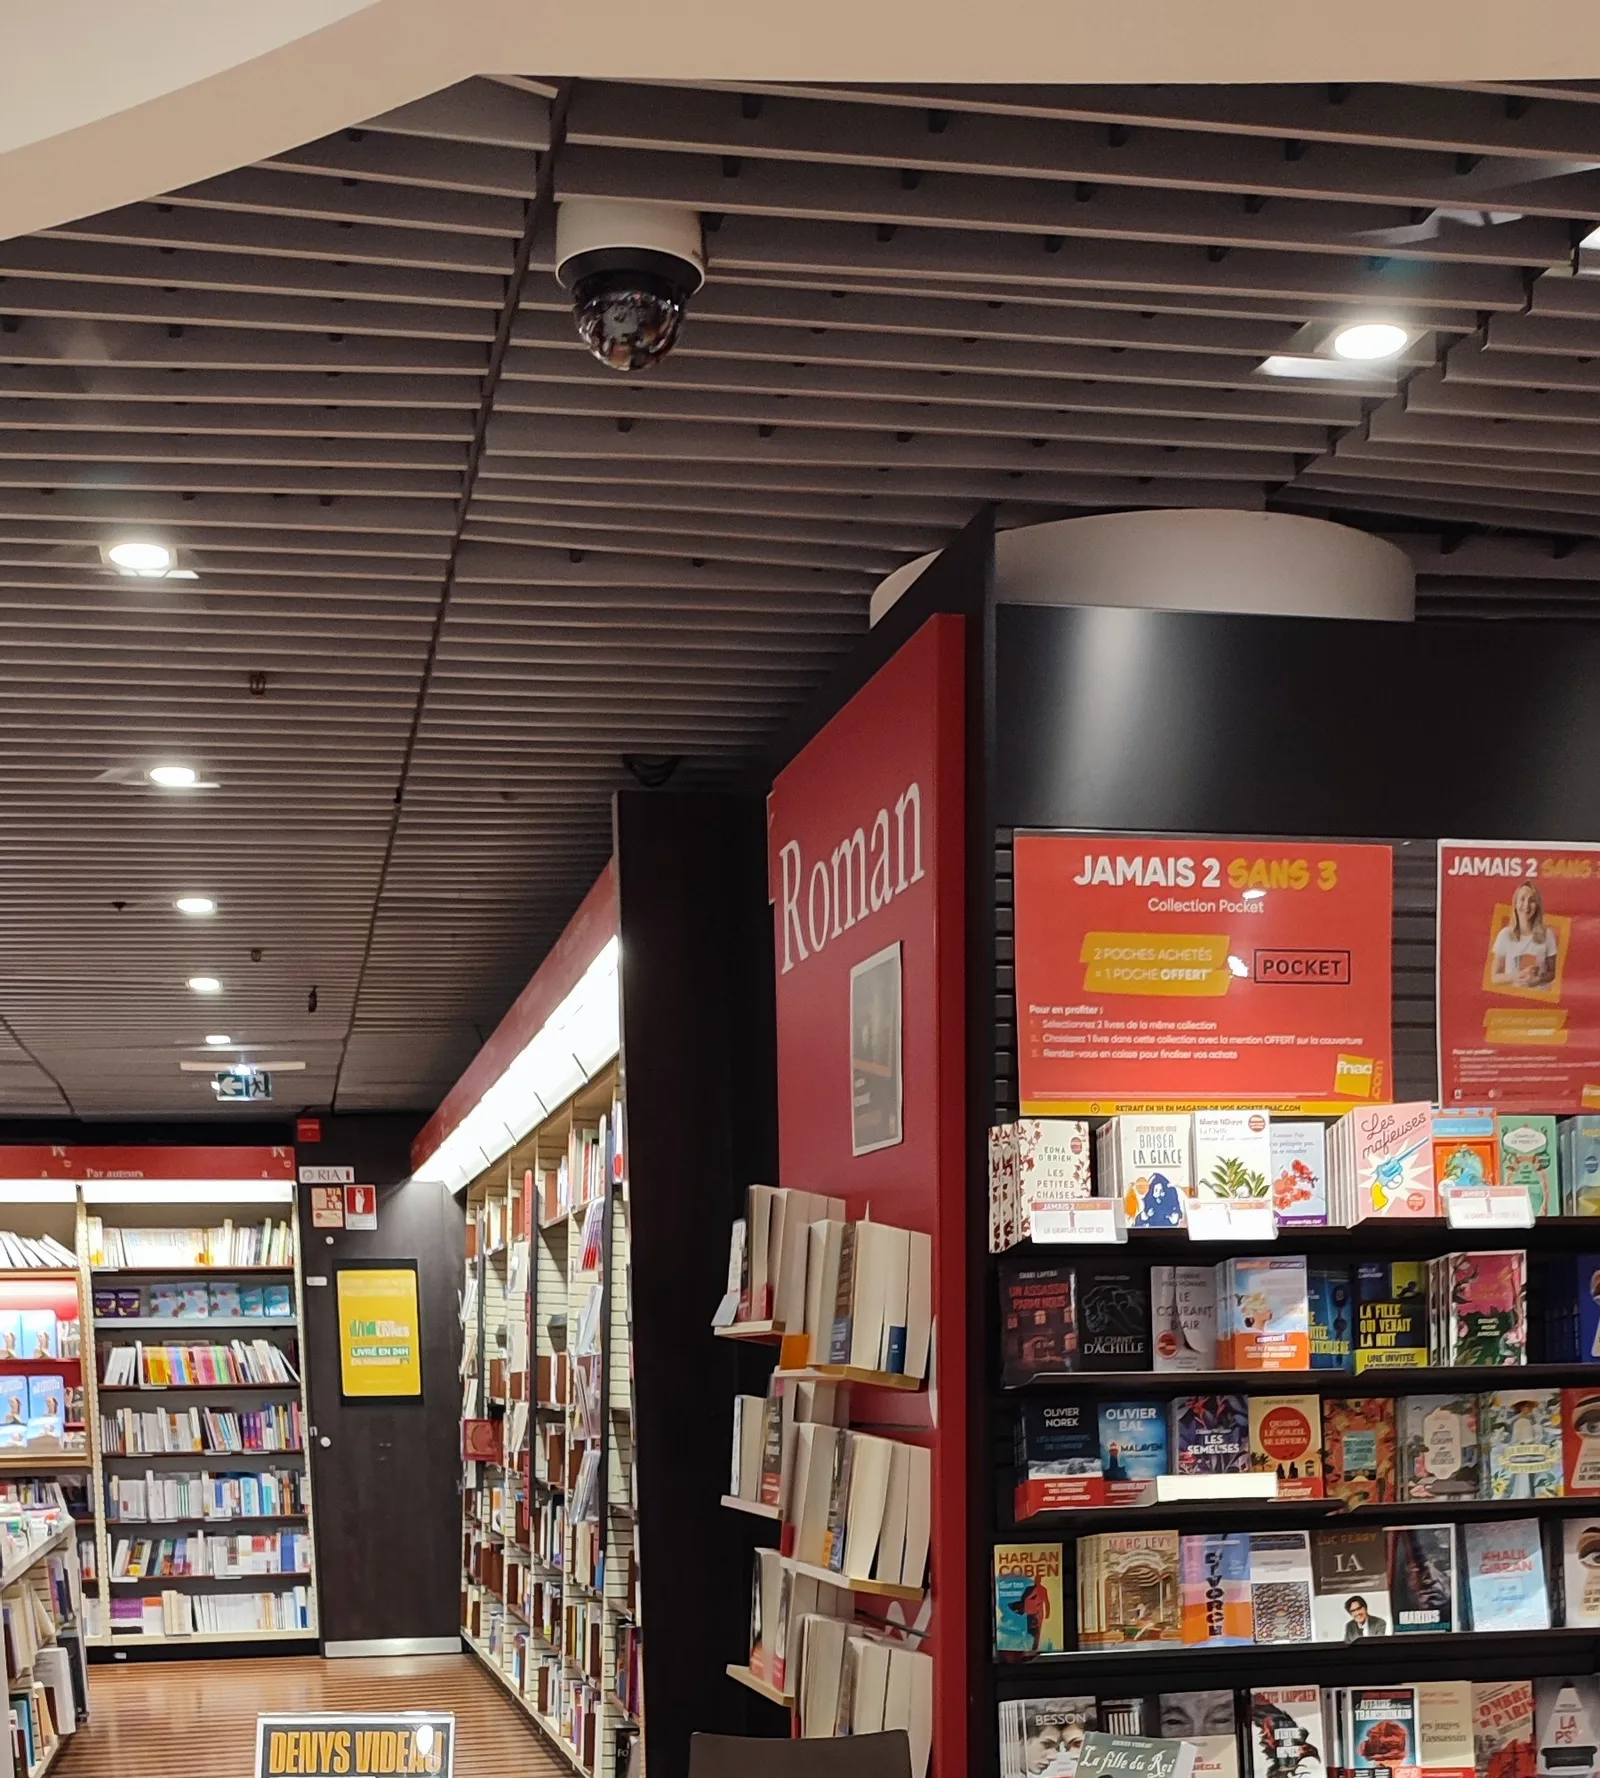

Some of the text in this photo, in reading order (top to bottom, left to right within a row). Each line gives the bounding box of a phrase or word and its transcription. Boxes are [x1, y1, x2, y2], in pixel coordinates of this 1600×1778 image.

[1073, 856, 1338, 890] JAMAIS 2 SANS 3
[1448, 856, 1523, 877] JAMAIS
[1526, 858, 1538, 877] 2
[779, 781, 925, 976] Roman
[1148, 898, 1264, 914] Collection Pocket
[1094, 946, 1212, 961] 2 POCHES ACHETÉS
[1262, 959, 1341, 976] POCKET
[1113, 969, 1158, 980] POCHE
[1029, 1005, 1050, 1014] Pour
[1052, 1006, 1063, 1014] en
[1126, 1021, 1138, 1029] de
[1139, 1021, 1148, 1030] la
[1177, 1021, 1217, 1030] collection
[1157, 1034, 1197, 1044] collection
[1229, 1036, 1263, 1045] mention
[1264, 1035, 1296, 1045] OFFERT
[1337, 1060, 1373, 1076] fnac
[1115, 1104, 1144, 1112] RETRAIT
[1145, 1104, 1155, 1112] EN
[1361, 1113, 1395, 1140] Les
[1138, 1134, 1175, 1149] BRISER
[1363, 1112, 1426, 1159] mafieuses
[1044, 1146, 1066, 1154] EDNA
[1133, 1149, 1182, 1165] LA GLACE
[87, 1168, 144, 1178] Par auteurs
[318, 1170, 341, 1181] RIA
[1047, 1169, 1064, 1178] LES
[1036, 1180, 1075, 1189] PETITES
[1036, 1190, 1076, 1199] CHAISES
[1024, 1283, 1069, 1297] ASSASSIN
[1179, 1292, 1191, 1303] LE
[1157, 1306, 1212, 1318] COURANT
[1360, 1304, 1402, 1319] LA FILLE
[1360, 1318, 1412, 1333] QUI VENAIT
[1360, 1333, 1396, 1348] LA NUIT
[1084, 1343, 1144, 1355] D'ACHILLE
[1367, 1353, 1415, 1363] UNE INVITÉE
[1044, 1407, 1079, 1417] OLIVIER
[1106, 1408, 1156, 1420] OLIVIER
[1045, 1418, 1079, 1427] NOREK
[1119, 1420, 1144, 1431] BAL
[1205, 1435, 1223, 1444] LES
[1187, 1444, 1239, 1455] SEMEUSES
[1108, 1537, 1171, 1550] MARC LEVY
[998, 1551, 1059, 1564] HARLAN
[1334, 1554, 1364, 1573] IA
[998, 1563, 1059, 1577] COBEN
[1480, 1562, 1532, 1574] GIBRAN
[1035, 1713, 1086, 1727] BESSON
[1560, 1716, 1577, 1730] LA
[269, 1731, 351, 1774] DENYS
[1080, 1745, 1176, 1778] La fille du Roi
